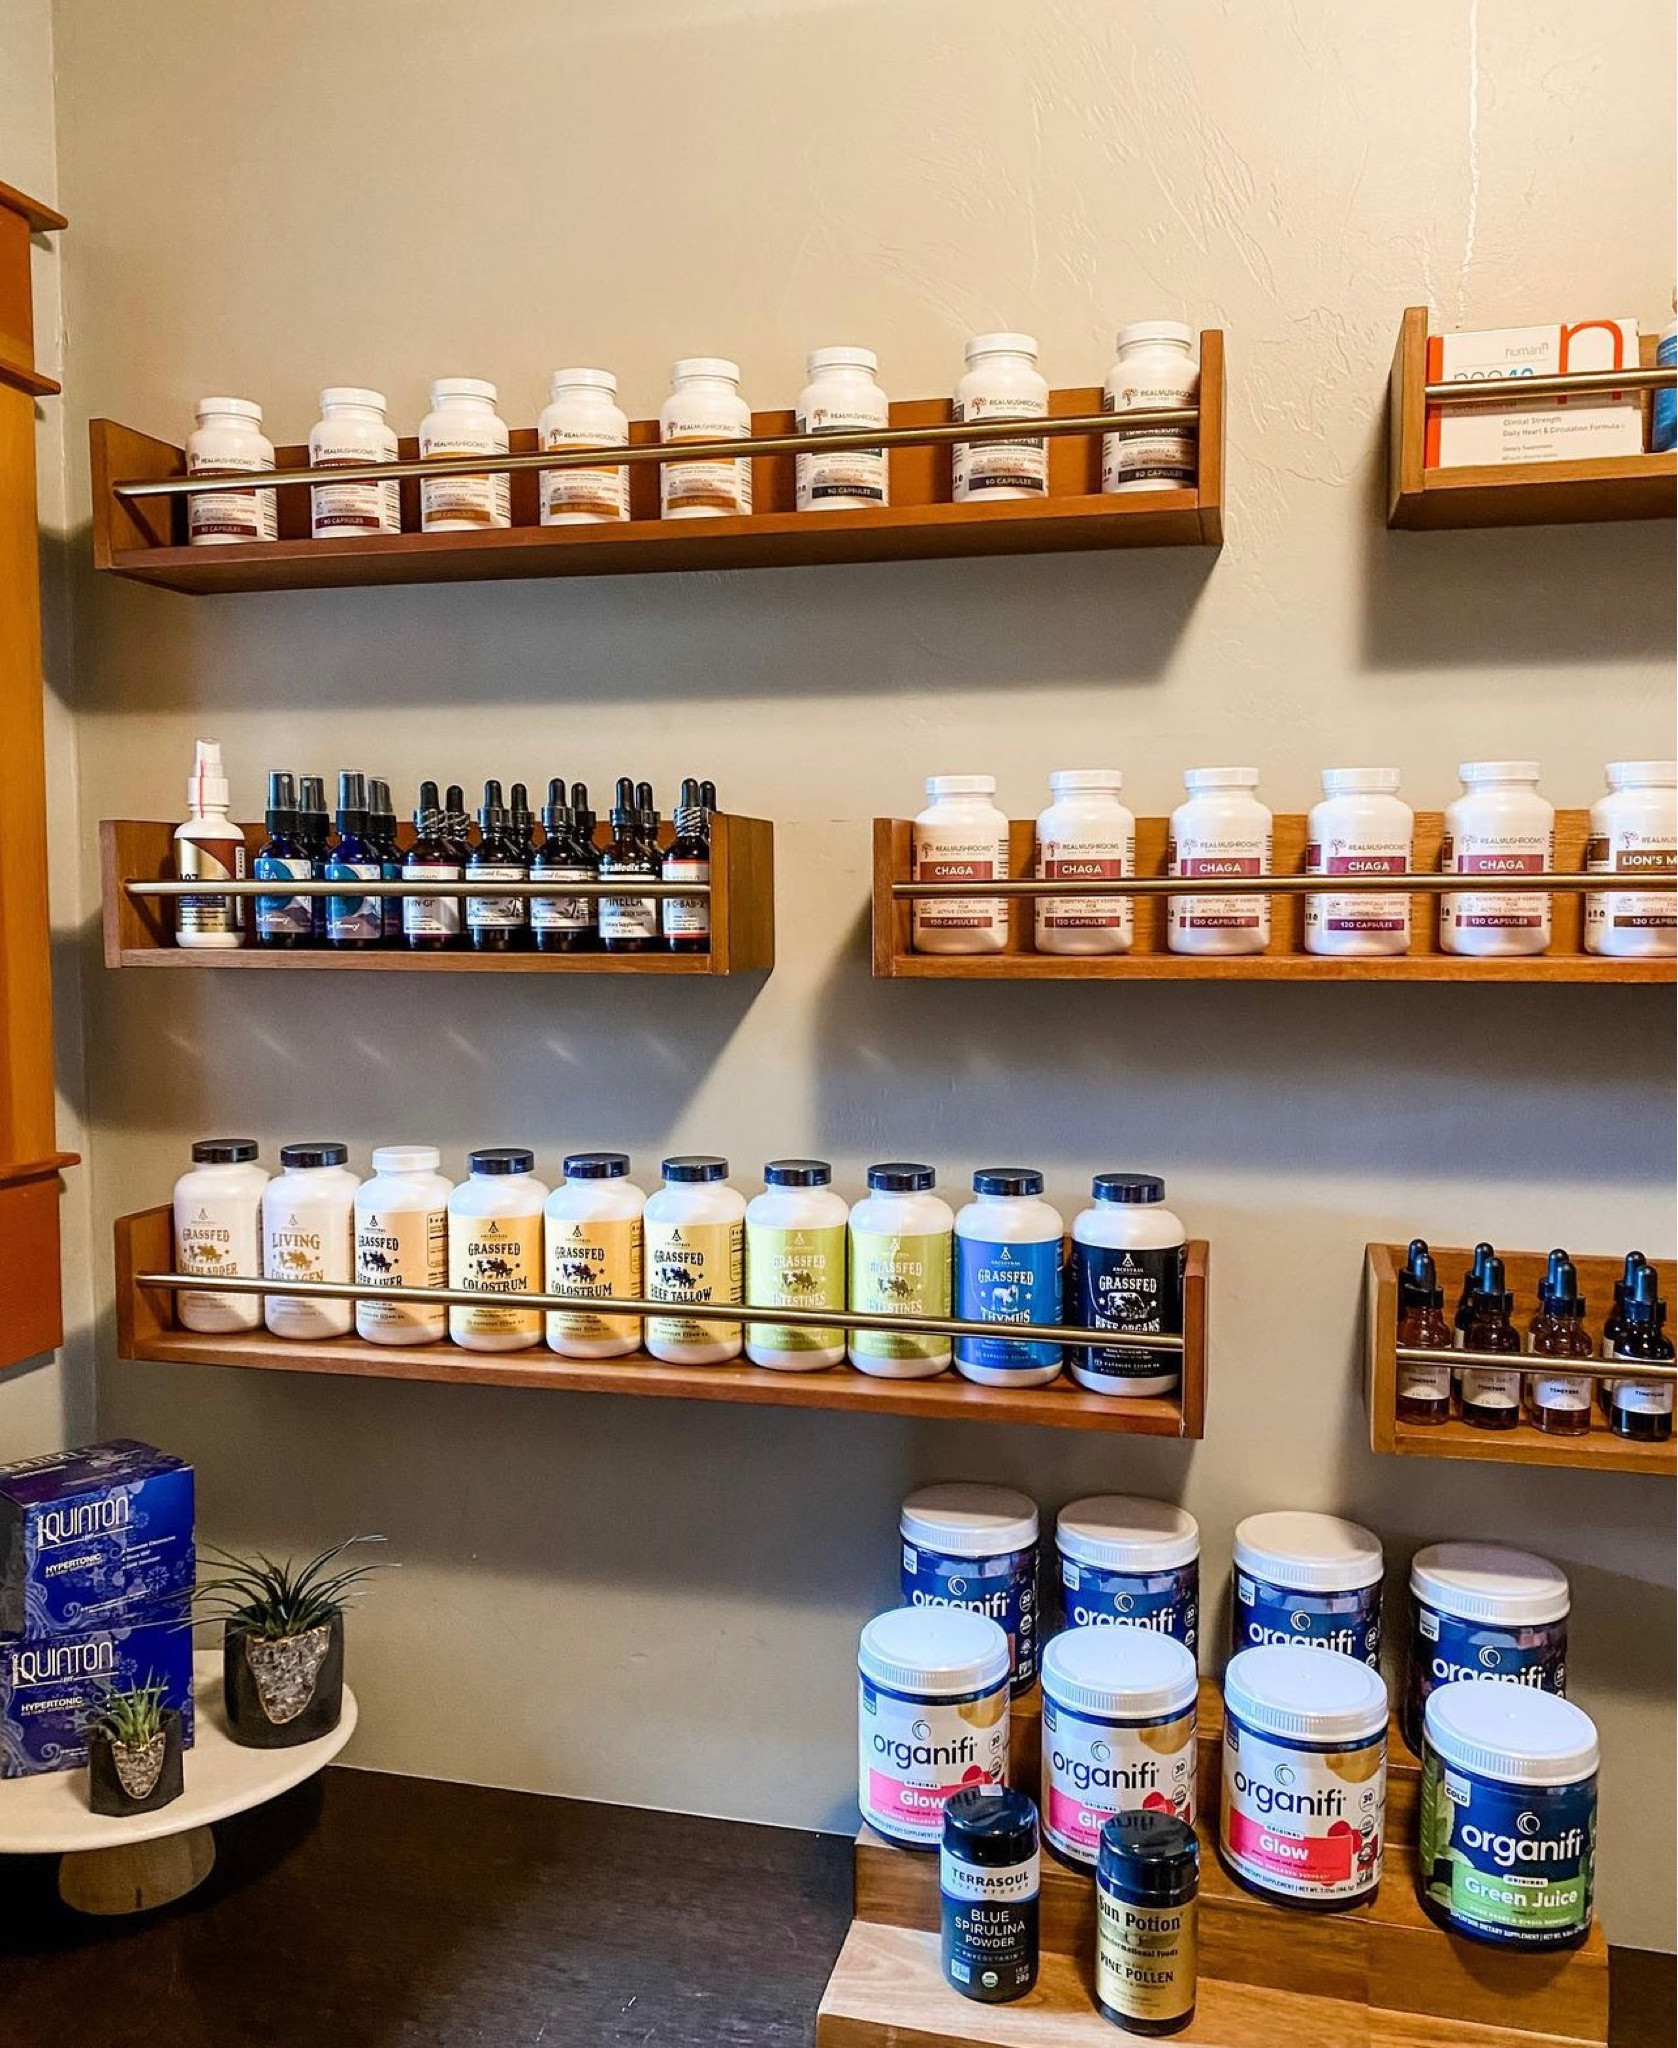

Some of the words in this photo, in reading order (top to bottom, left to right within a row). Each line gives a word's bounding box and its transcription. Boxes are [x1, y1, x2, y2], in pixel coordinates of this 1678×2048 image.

[1140, 389, 1191, 398] REALMUSHROO
[1199, 863, 1242, 873] CHAGA
[1348, 861, 1391, 871] CHAGA
[1479, 860, 1525, 870] CHAGA
[1622, 855, 1663, 866] LION'S
[934, 866, 974, 876] CHAGA
[1061, 865, 1102, 874] CHAGA
[943, 918, 978, 926] CAPSULES
[1070, 918, 1106, 926] CAPSULES
[1207, 918, 1246, 926] CAPSULES
[1487, 917, 1528, 925] CAPSULES
[1649, 917, 1677, 925] CAPSU
[182, 1227, 230, 1243] GRASSFED
[272, 1232, 321, 1250] LIVING
[468, 1242, 521, 1256] GRASSFED
[555, 1245, 604, 1261] GRASSFED
[654, 1249, 704, 1266] GRASSFED
[773, 1254, 826, 1269] GRASSFED
[869, 1261, 922, 1277] GRASSFED
[977, 1268, 1034, 1285] GRASSFED
[462, 1276, 528, 1292] COLOSTRUM
[551, 1281, 612, 1297] COLOSTRUM
[1099, 1275, 1157, 1293] GRASSFED
[670, 1286, 712, 1303] TALLOW
[980, 1305, 1031, 1324] THYMUS
[46, 1553, 102, 1574] HYPERTONIC
[21, 1696, 83, 1713] HYPERTONIC
[873, 1734, 974, 1770] organifi
[1053, 1751, 1156, 1790] organifi
[906, 1780, 939, 1789] ORIGINAL
[900, 1791, 946, 1810] Glow
[1234, 1771, 1343, 1817] organifi
[1446, 1787, 1468, 1803] COLD
[1078, 1811, 1103, 1830] Gl
[1266, 1824, 1301, 1839] ORIGINAL
[1259, 1835, 1309, 1861] Glow
[1460, 1824, 1582, 1867] organifi
[952, 1867, 1029, 1888] TERRASOUL
[1262, 1874, 1295, 1890] SUPPLEMENT
[1506, 1876, 1545, 1886] ORIGINAL
[1464, 1876, 1528, 1907] Green
[1532, 1889, 1578, 1908] Juice
[971, 1909, 1010, 1923] BLUE
[1100, 1894, 1120, 1924] Sun
[1125, 1911, 1181, 1933] Potion
[955, 1916, 1026, 1937] SPIRULINA
[965, 1935, 1015, 1948] POWDER
[1100, 1928, 1156, 1958] ransformational
[1504, 1930, 1540, 1940] SUPPLEMENT
[1100, 1951, 1123, 1976] PINE
[1125, 1967, 1174, 1984] POLLEN
